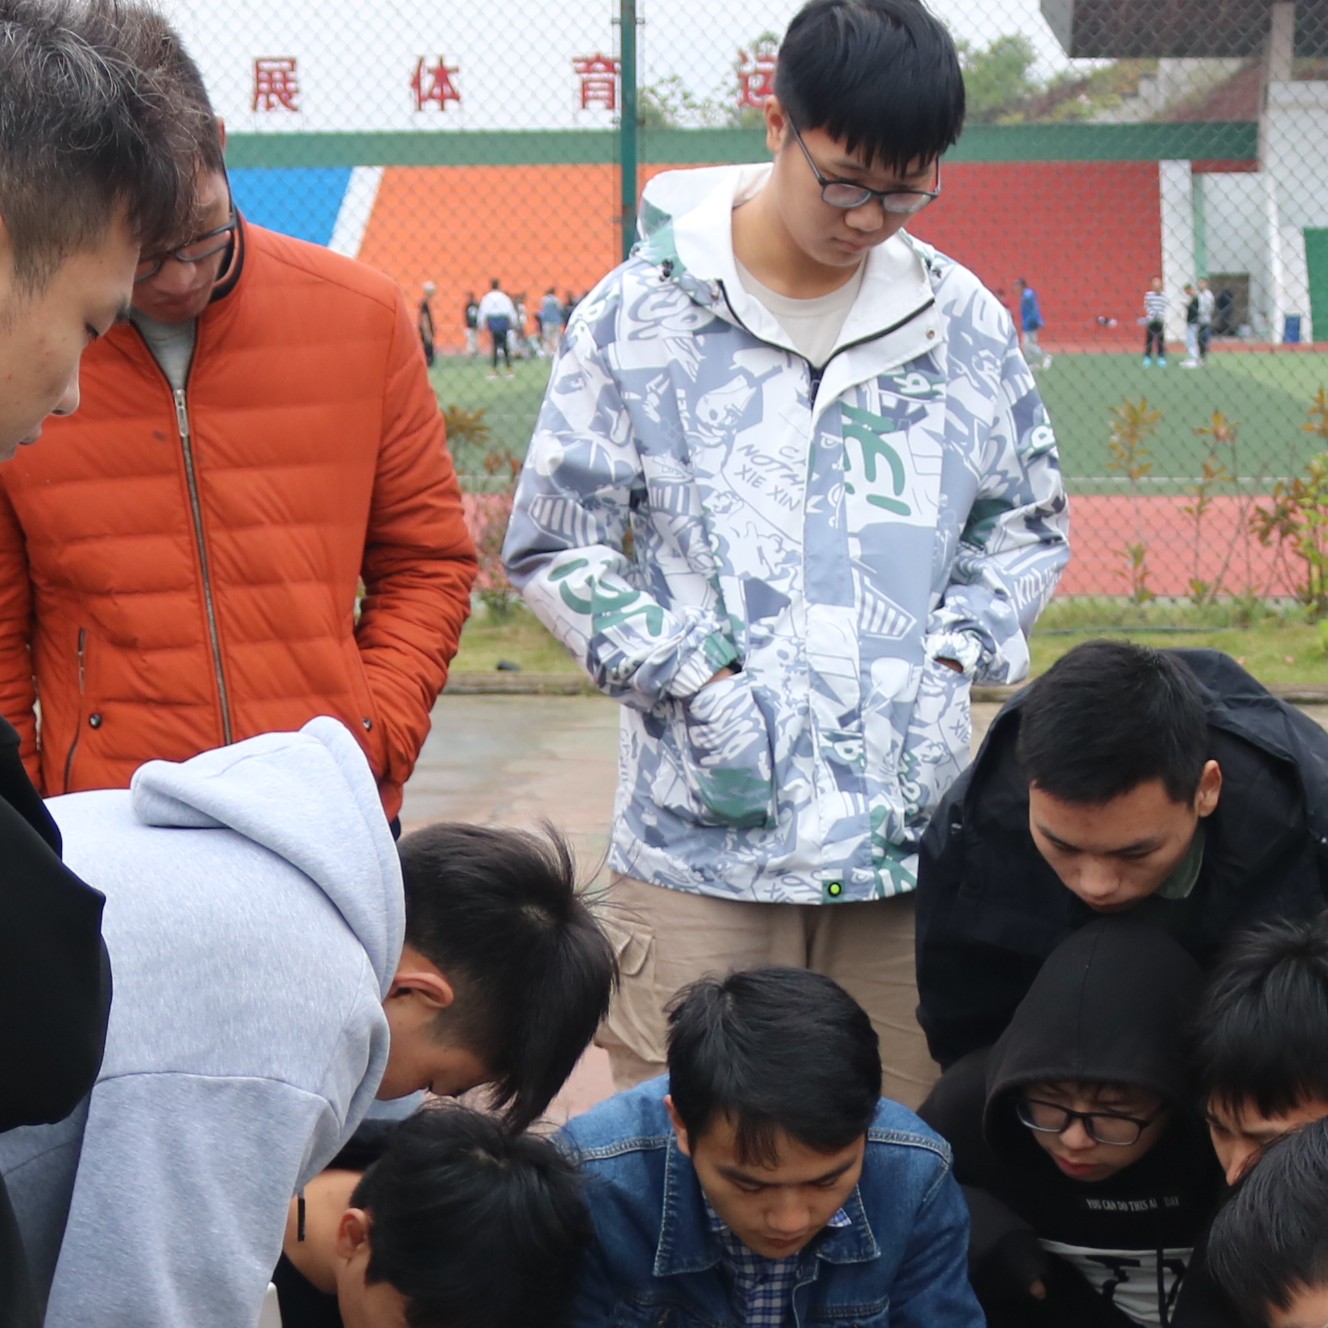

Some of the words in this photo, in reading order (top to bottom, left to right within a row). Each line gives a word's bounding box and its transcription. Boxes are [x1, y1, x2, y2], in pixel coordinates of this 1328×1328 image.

[734, 463, 768, 489] XIE
[766, 484, 802, 511] XIN
[1086, 1198, 1102, 1210] YOU
[1102, 1199, 1117, 1210] CAN
[1117, 1200, 1128, 1211] DO
[1128, 1199, 1149, 1211] THIS
